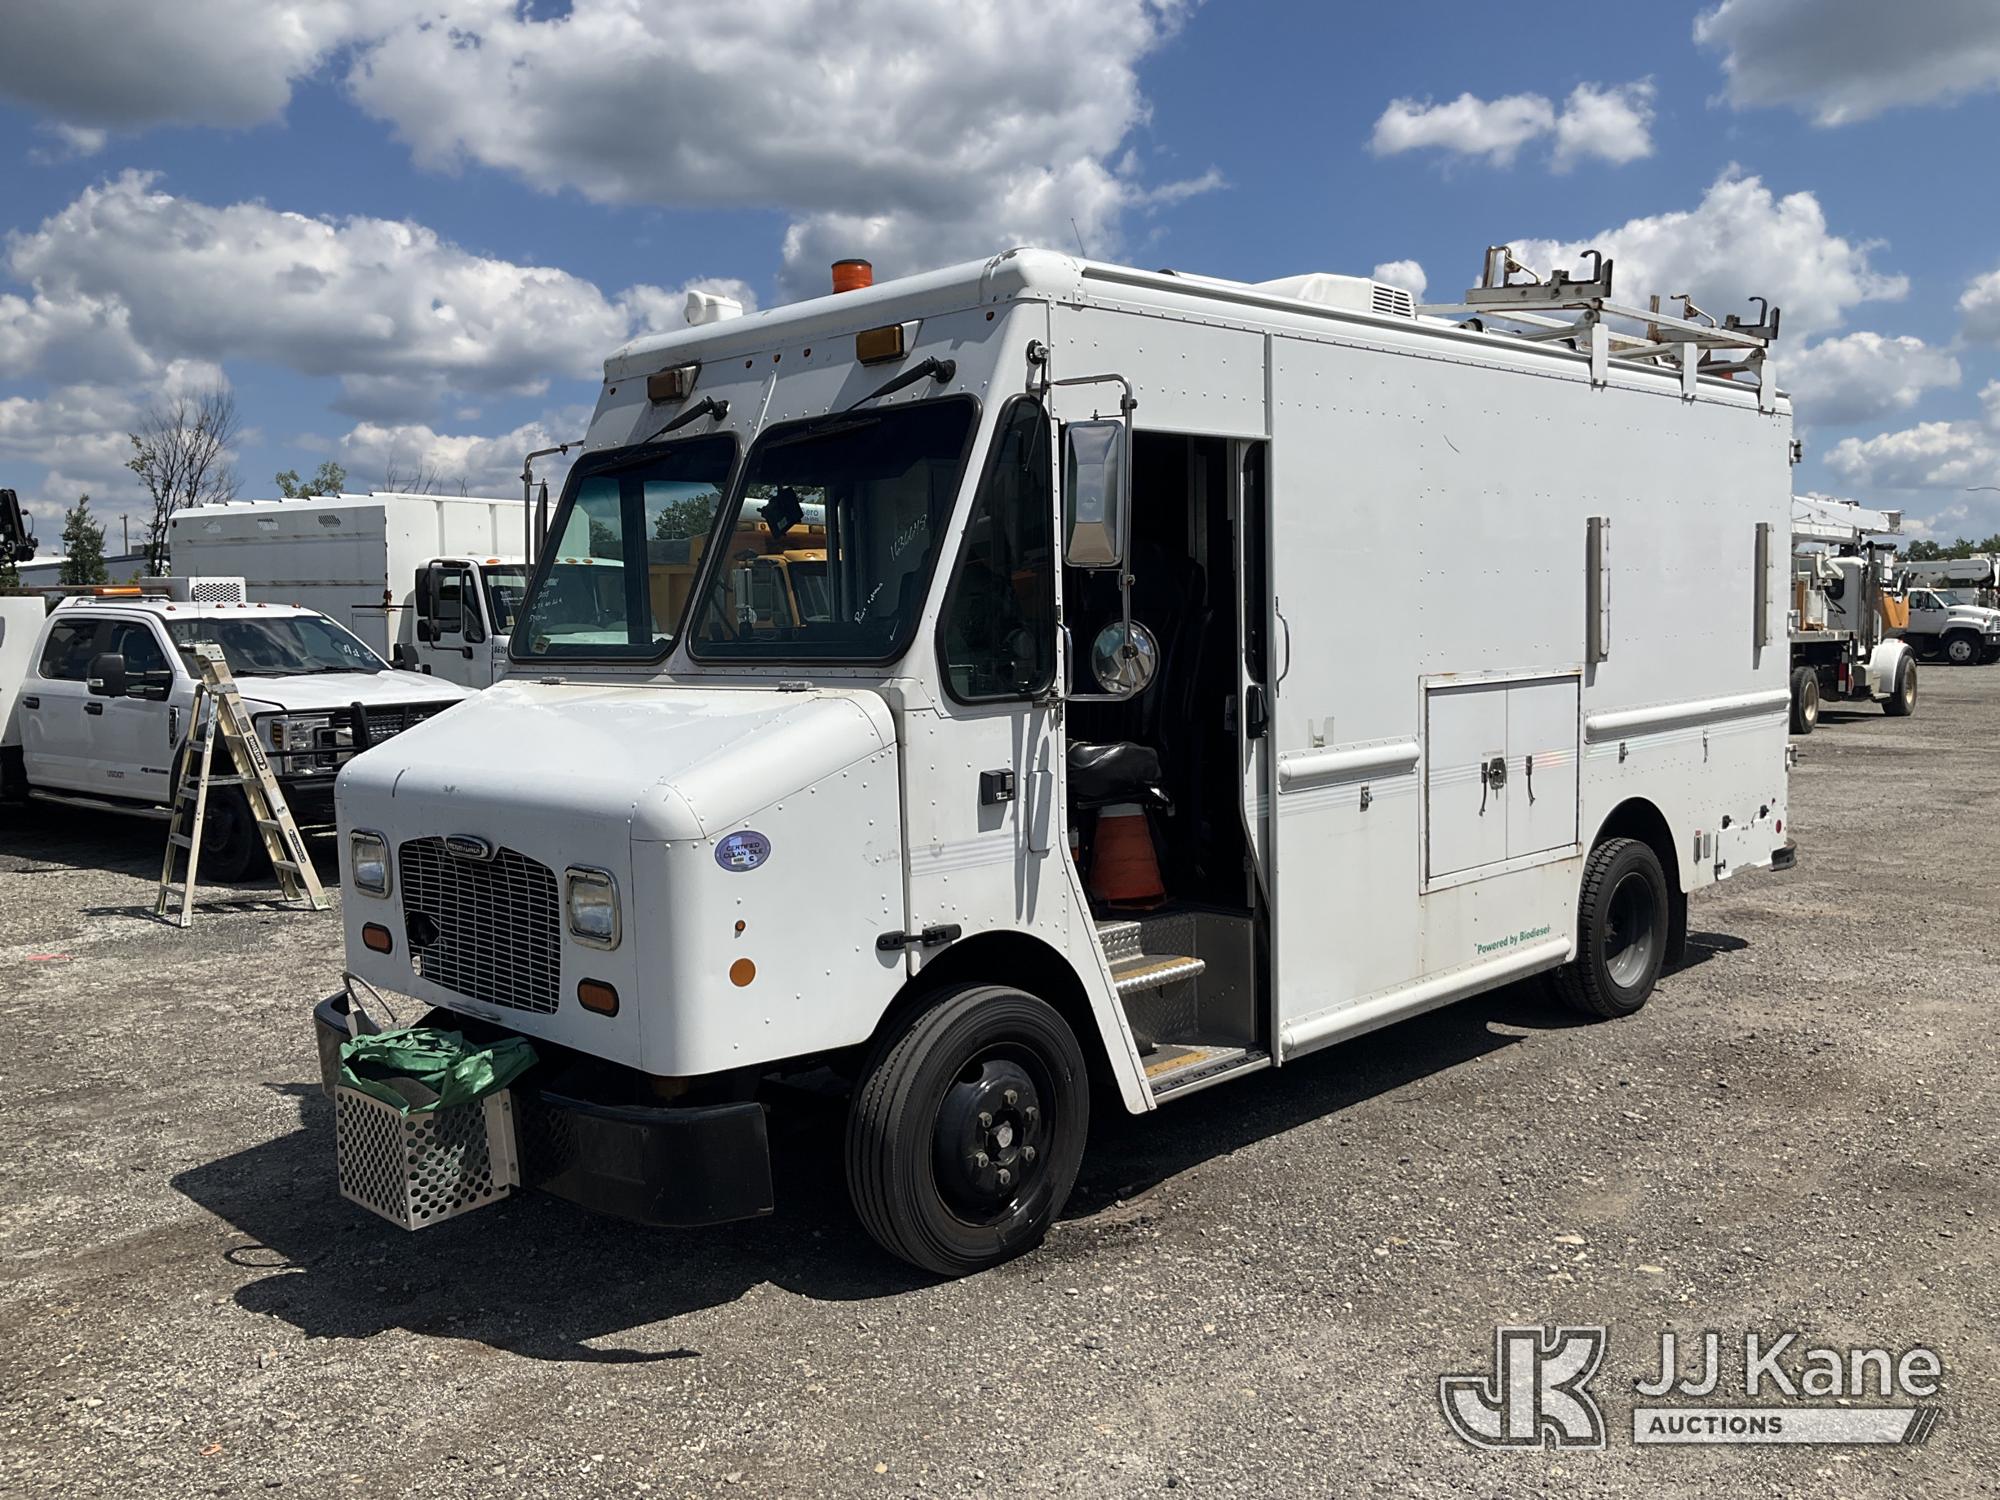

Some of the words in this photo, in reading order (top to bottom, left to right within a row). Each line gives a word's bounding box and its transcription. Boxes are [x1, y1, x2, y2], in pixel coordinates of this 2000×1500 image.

[723, 850, 747, 859] CLEAN
[748, 847, 764, 855] IDLE
[726, 842, 760, 852] CERTIFIED
[1477, 936, 1508, 954] Powered
[1509, 934, 1518, 946] by
[1519, 926, 1550, 942] Biodiesel
